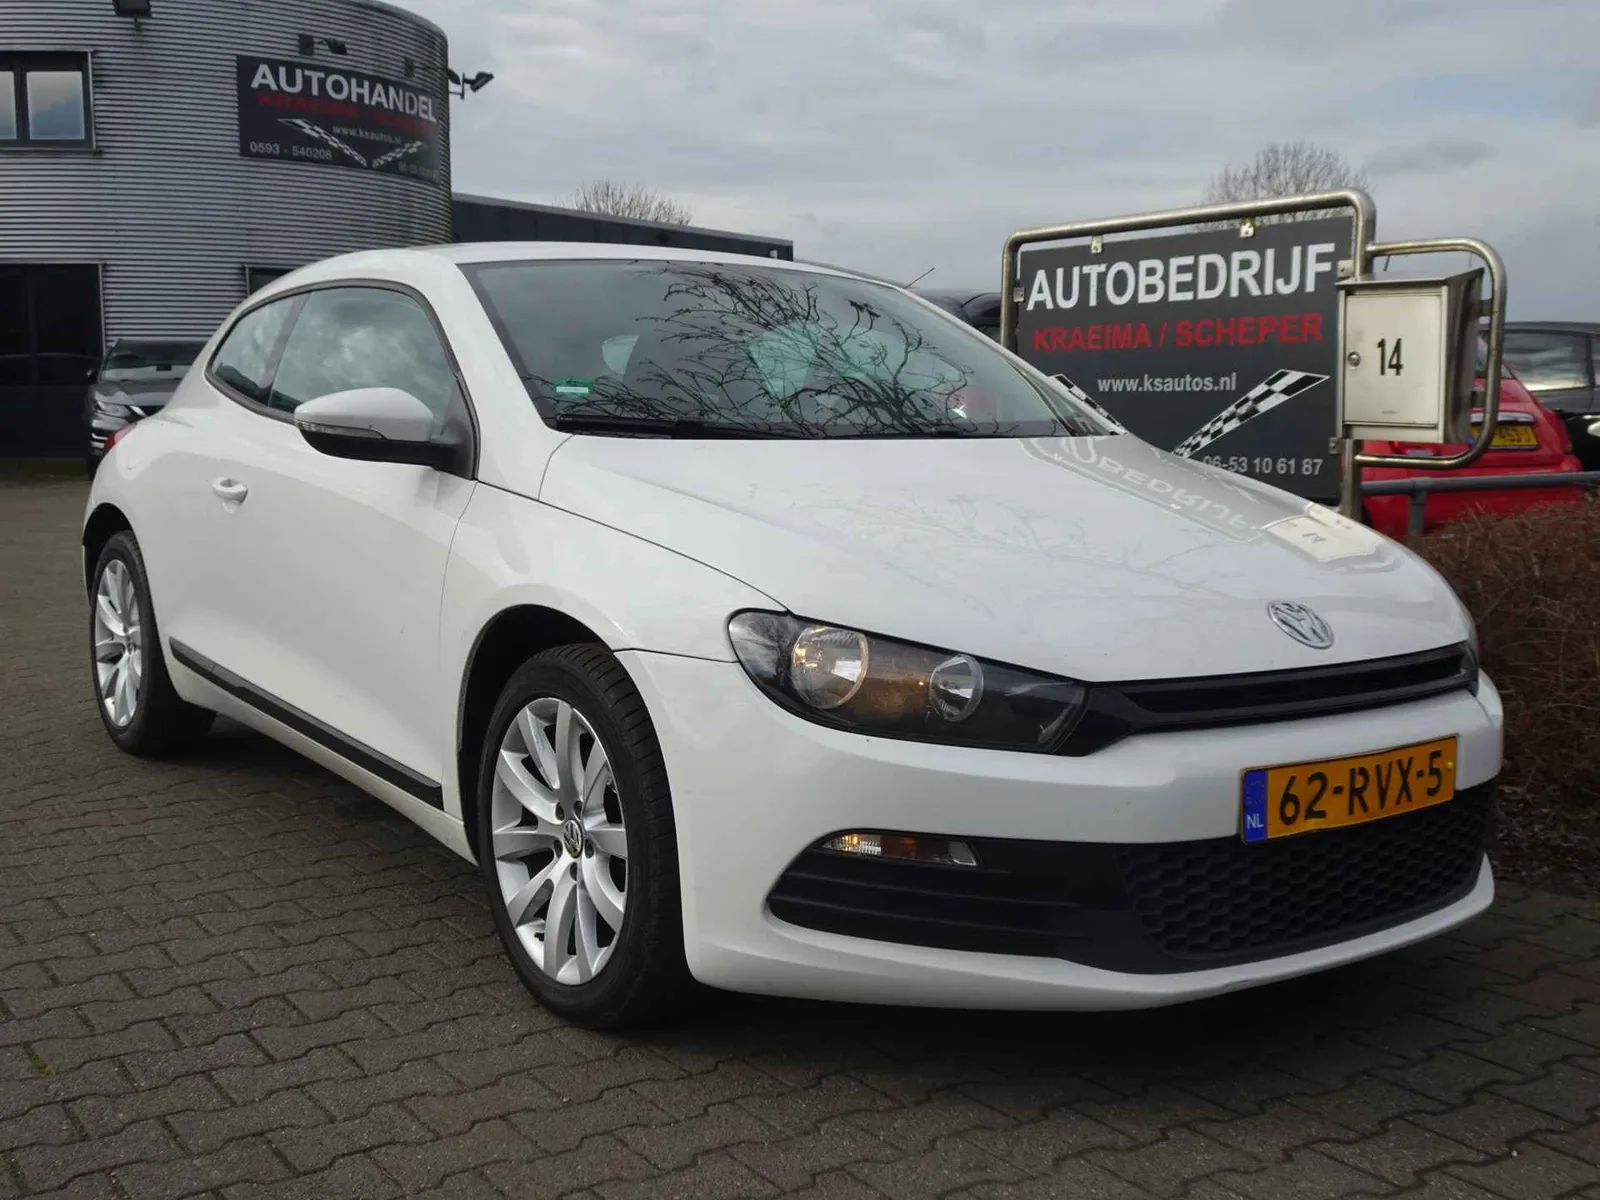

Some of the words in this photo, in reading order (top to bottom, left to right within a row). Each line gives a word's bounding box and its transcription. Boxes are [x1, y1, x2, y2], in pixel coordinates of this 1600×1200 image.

[251, 63, 437, 122] AUTOHANDEL
[249, 141, 280, 155] 0593
[1026, 242, 1336, 310] AUTOBEDRIJF
[1033, 321, 1150, 353] KRAEIMA
[1159, 321, 1168, 347] /
[1175, 313, 1324, 347] SCHEPER
[1376, 338, 1403, 376] 14
[1097, 372, 1237, 392] www.ksautos.nl
[1253, 457, 1272, 473] 10
[1276, 458, 1295, 474] 61
[1302, 458, 1323, 475] 87
[1279, 750, 1443, 826] 62-RVX-5
[1246, 813, 1264, 829] NL
